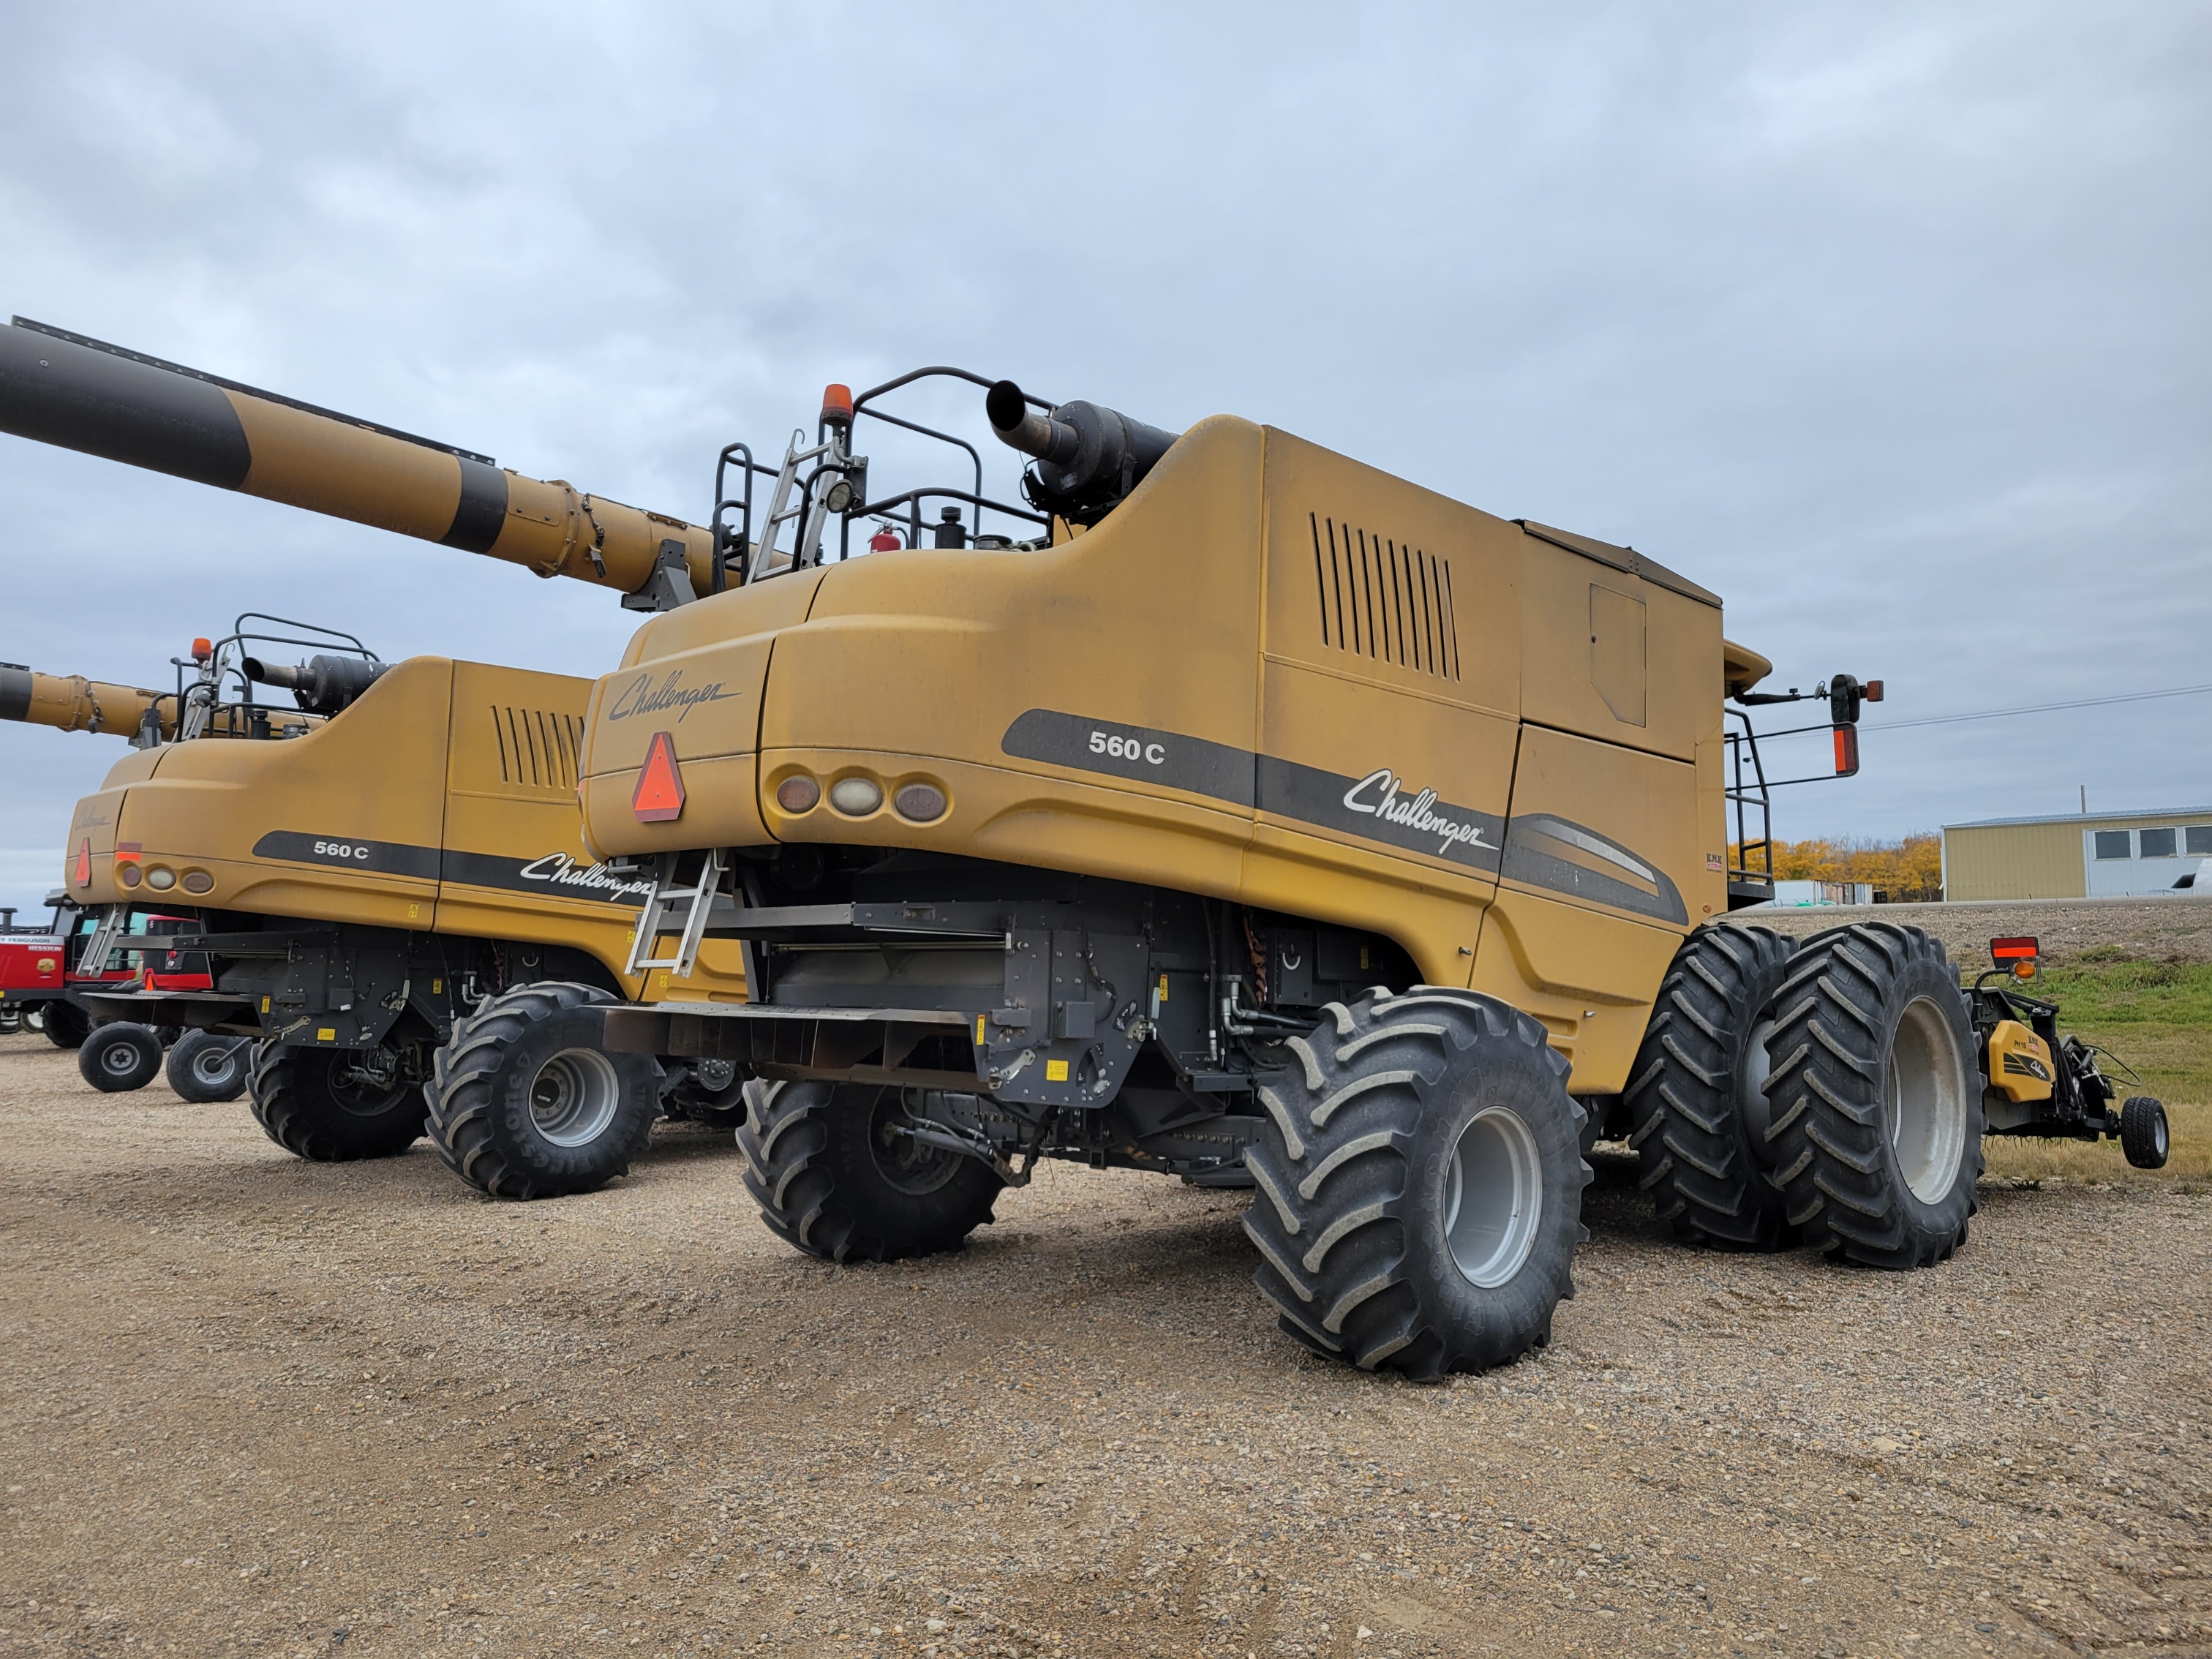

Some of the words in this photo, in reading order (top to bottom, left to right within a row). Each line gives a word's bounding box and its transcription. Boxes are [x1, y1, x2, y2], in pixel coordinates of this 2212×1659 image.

[609, 669, 742, 723] Challenger
[1088, 731, 1141, 761] 560
[1145, 743, 1165, 764] C
[1343, 769, 1500, 855] Challenger
[314, 840, 351, 857] 560
[353, 847, 369, 859] C
[2014, 1039, 2020, 1047] PH
